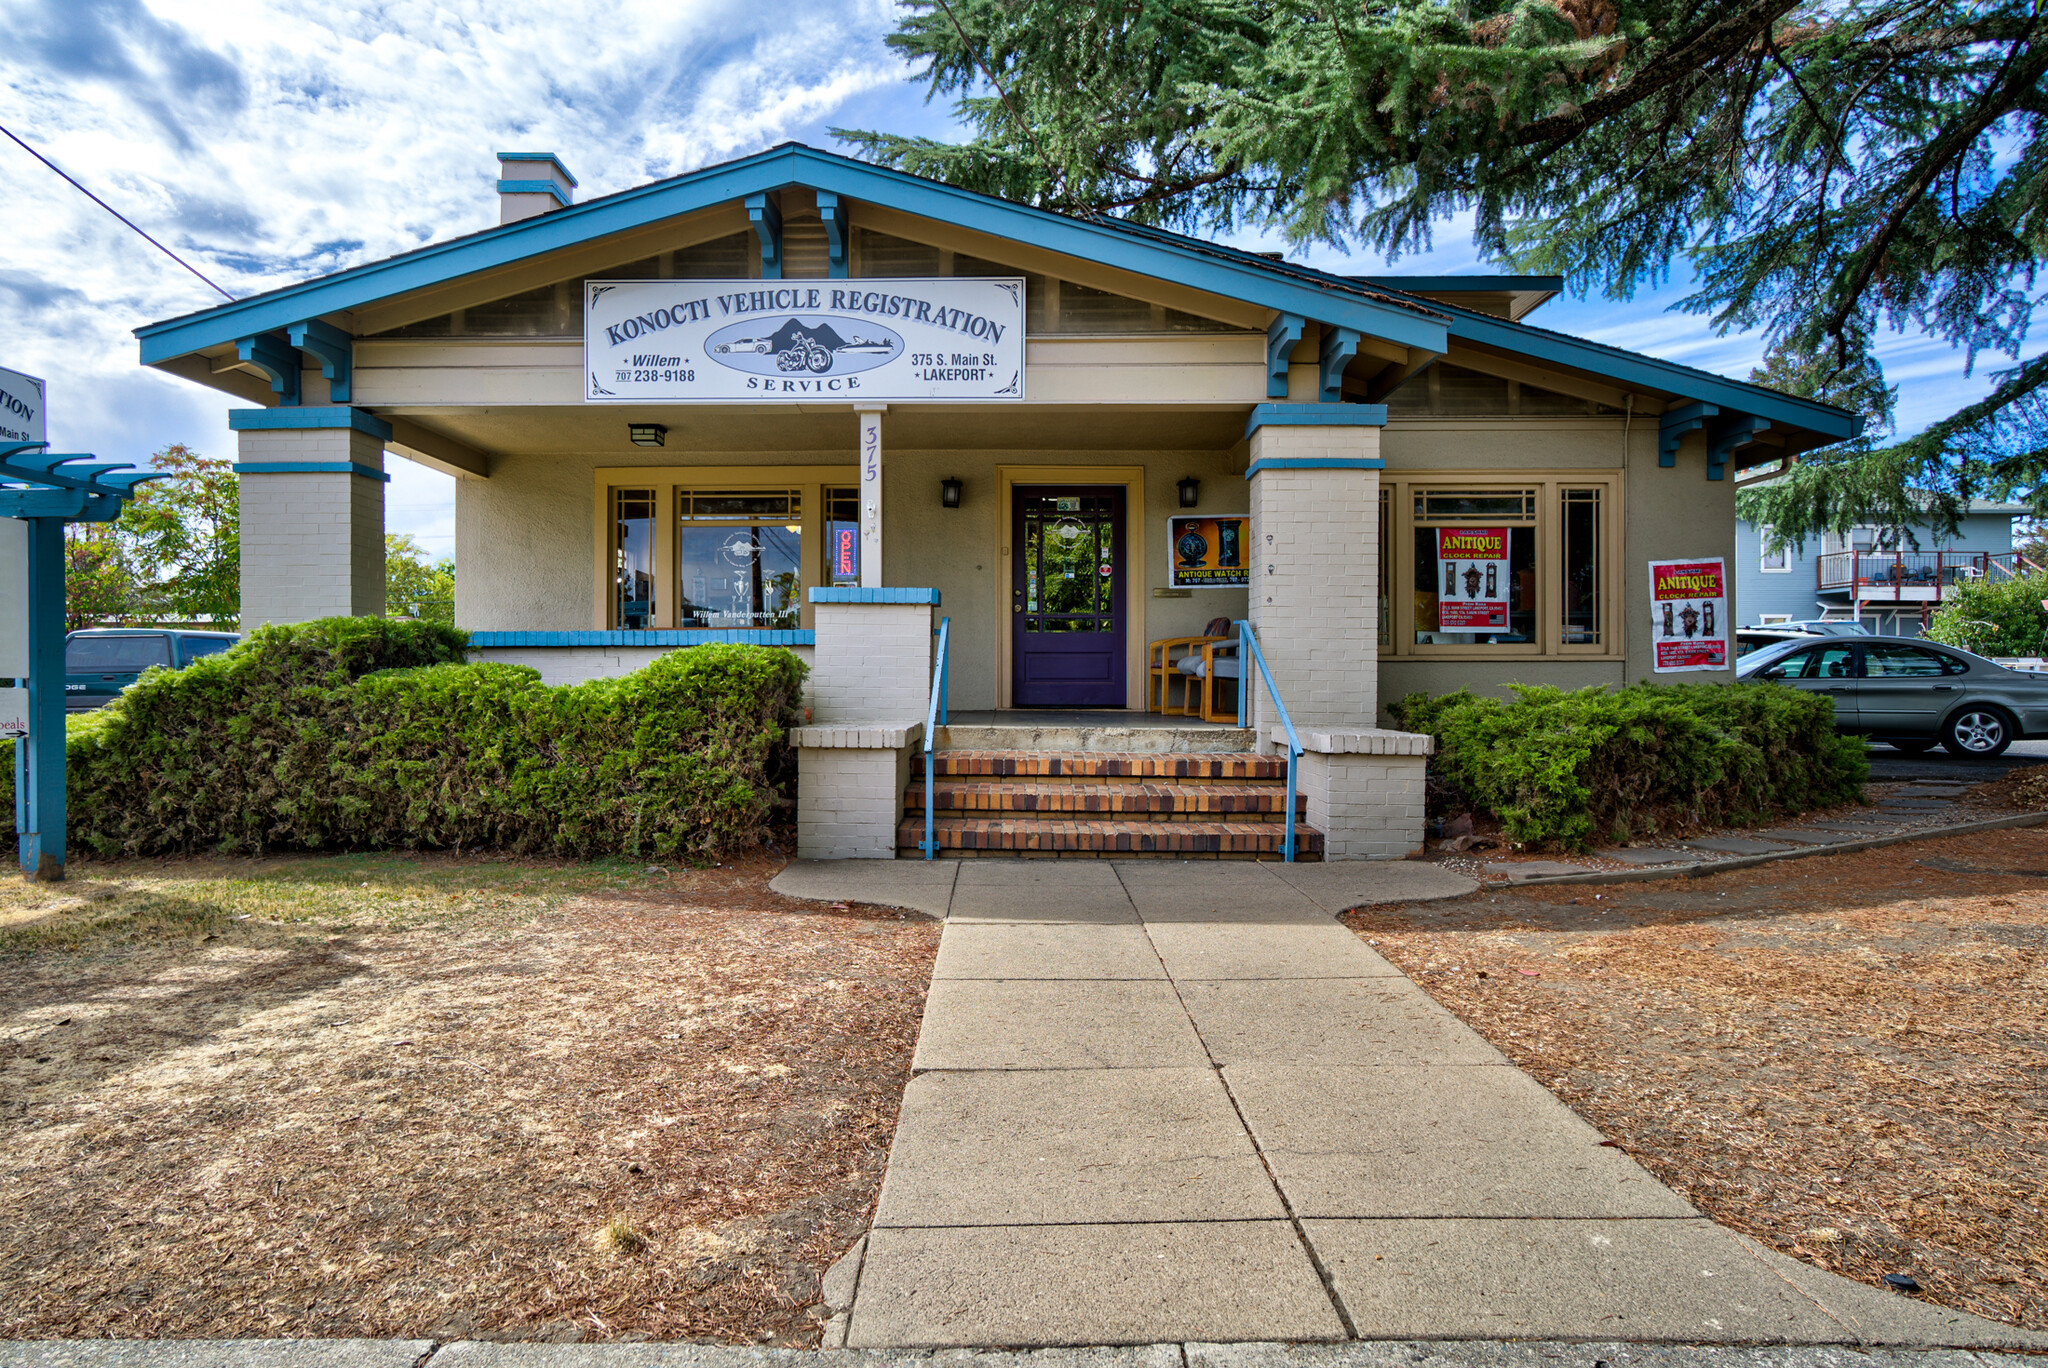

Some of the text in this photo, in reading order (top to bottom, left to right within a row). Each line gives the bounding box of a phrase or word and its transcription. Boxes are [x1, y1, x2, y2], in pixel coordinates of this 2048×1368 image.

[604, 289, 1006, 347] KONOCTI VEHICLE REGISTRATION
[633, 354, 681, 367] Willem
[911, 353, 998, 366] 375 S. Main St.
[616, 369, 695, 382] 707 238-9188
[923, 368, 987, 381] LAKEPORT
[747, 377, 861, 392] SERVICE
[865, 426, 877, 481] 375
[1442, 536, 1502, 552] ANITIQUE
[840, 530, 851, 574] OPEN
[1658, 575, 1717, 591] ANITIQUE
[692, 610, 720, 618] Willem
